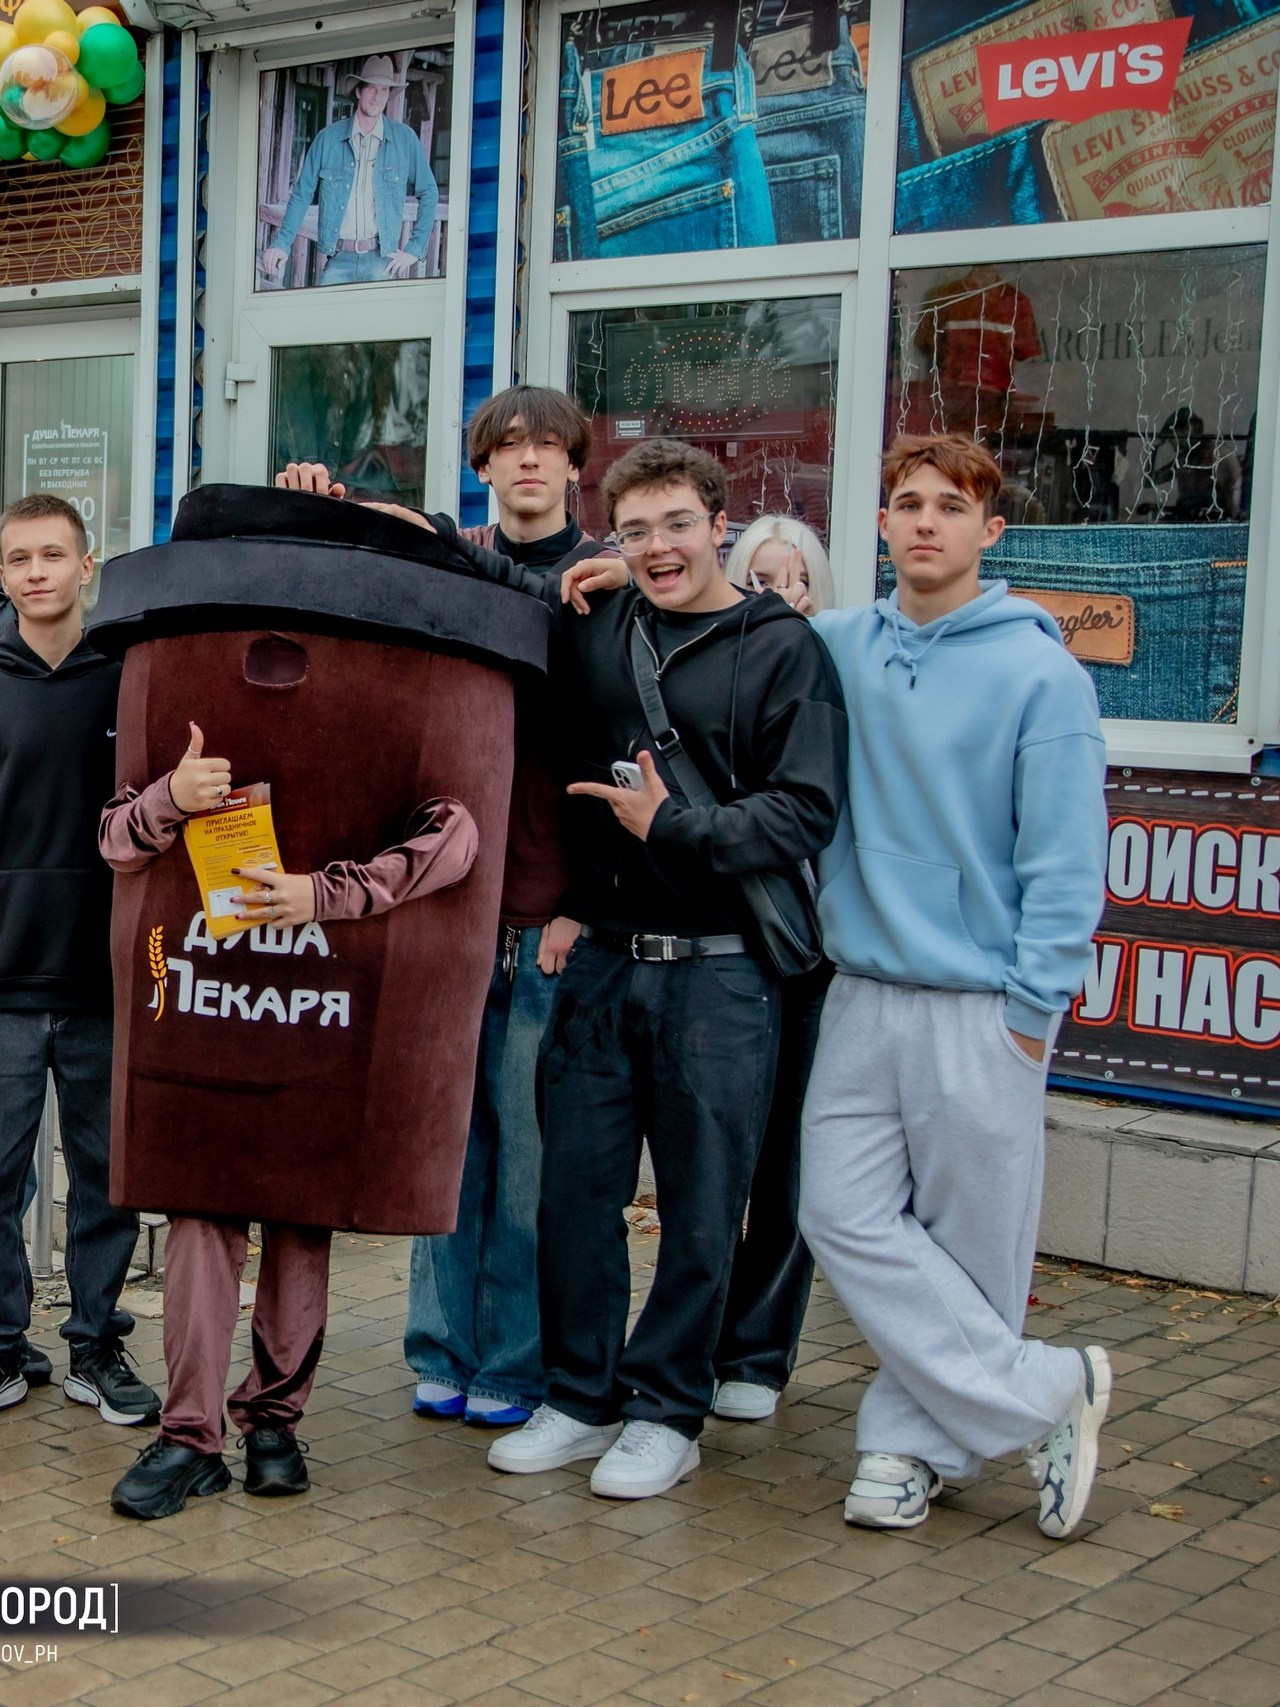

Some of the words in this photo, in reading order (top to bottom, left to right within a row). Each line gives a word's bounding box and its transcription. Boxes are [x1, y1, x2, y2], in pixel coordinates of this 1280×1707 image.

[606, 73, 692, 122] Lee
[940, 66, 978, 99] LEV
[1072, 124, 1127, 167] LEVI
[1131, 73, 1234, 137] STAUSS
[1238, 65, 1257, 87] &
[1099, 143, 1190, 190] ORIGINAL
[1126, 164, 1175, 196] QUALITY
[623, 357, 791, 405] ОТКРЫТО
[32, 429, 59, 441] ДУША
[60, 420, 100, 440] ПЕКАРЯ
[27, 457, 37, 466] ПН
[39, 457, 48, 465] ВТ
[49, 457, 59, 465] СР
[60, 456, 70, 465] ЧТ
[71, 456, 81, 465] ПТ
[82, 456, 92, 465] СБ
[94, 456, 103, 464] ВС
[39, 469, 52, 477] БЕЗ
[53, 468, 90, 477] ПЕРЕРЫВА
[40, 481, 46, 489] И
[47, 480, 88, 490] ВЫХОДНЫХ
[1053, 604, 1125, 646] ngler
[205, 812, 254, 827] ПРИГЛАШАЕМ
[213, 820, 257, 834] ПРАЗДНИЧНОЕ
[1108, 822, 1280, 913] ОИСК
[184, 910, 330, 957] ДША
[148, 957, 350, 1028] ПЕКАРЯ
[1135, 949, 1280, 1043] НАС
